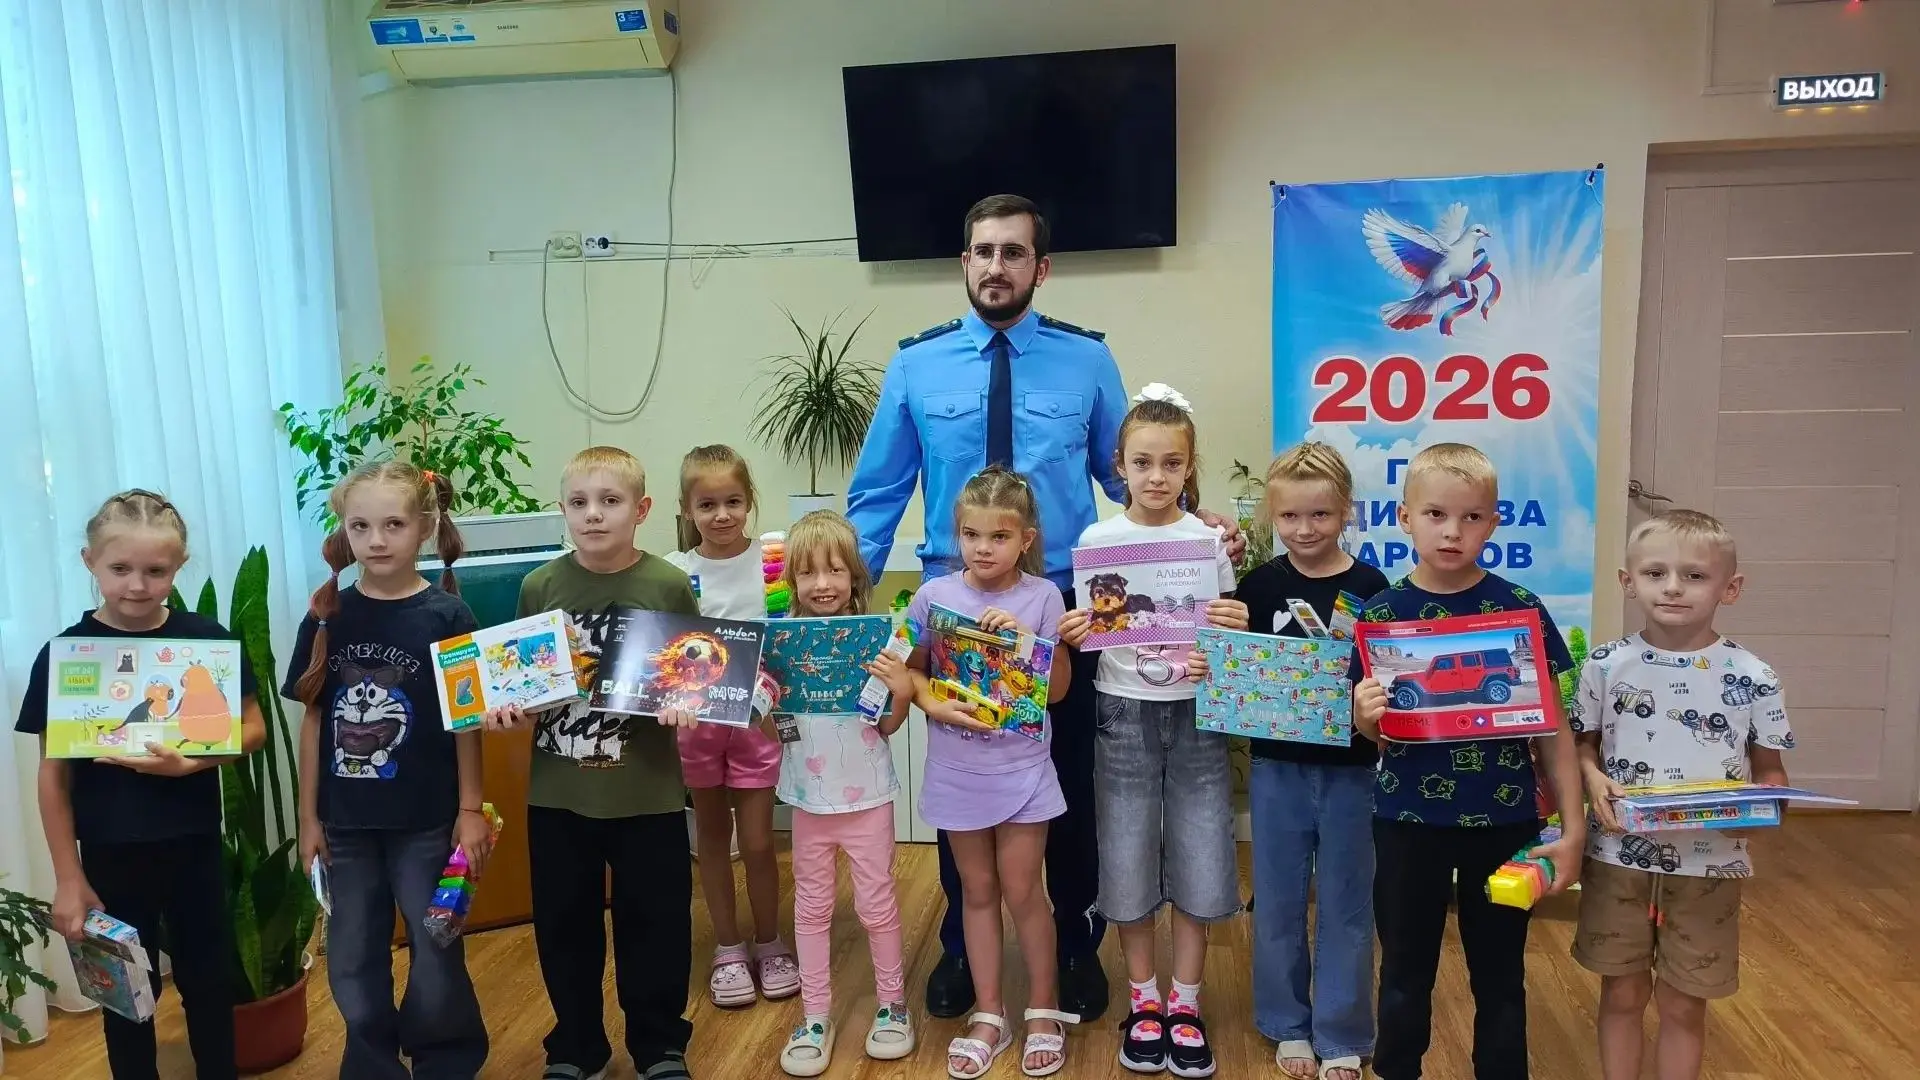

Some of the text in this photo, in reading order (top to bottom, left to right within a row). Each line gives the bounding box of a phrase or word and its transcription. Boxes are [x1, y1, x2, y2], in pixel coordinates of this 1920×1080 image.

[1783, 77, 1875, 100] ВЫХОД
[1311, 353, 1551, 424] 2026
[1156, 568, 1201, 579] АЛЬБОМ
[714, 626, 757, 638] Альбом
[601, 680, 649, 698] BALL
[708, 685, 749, 702] RAGE
